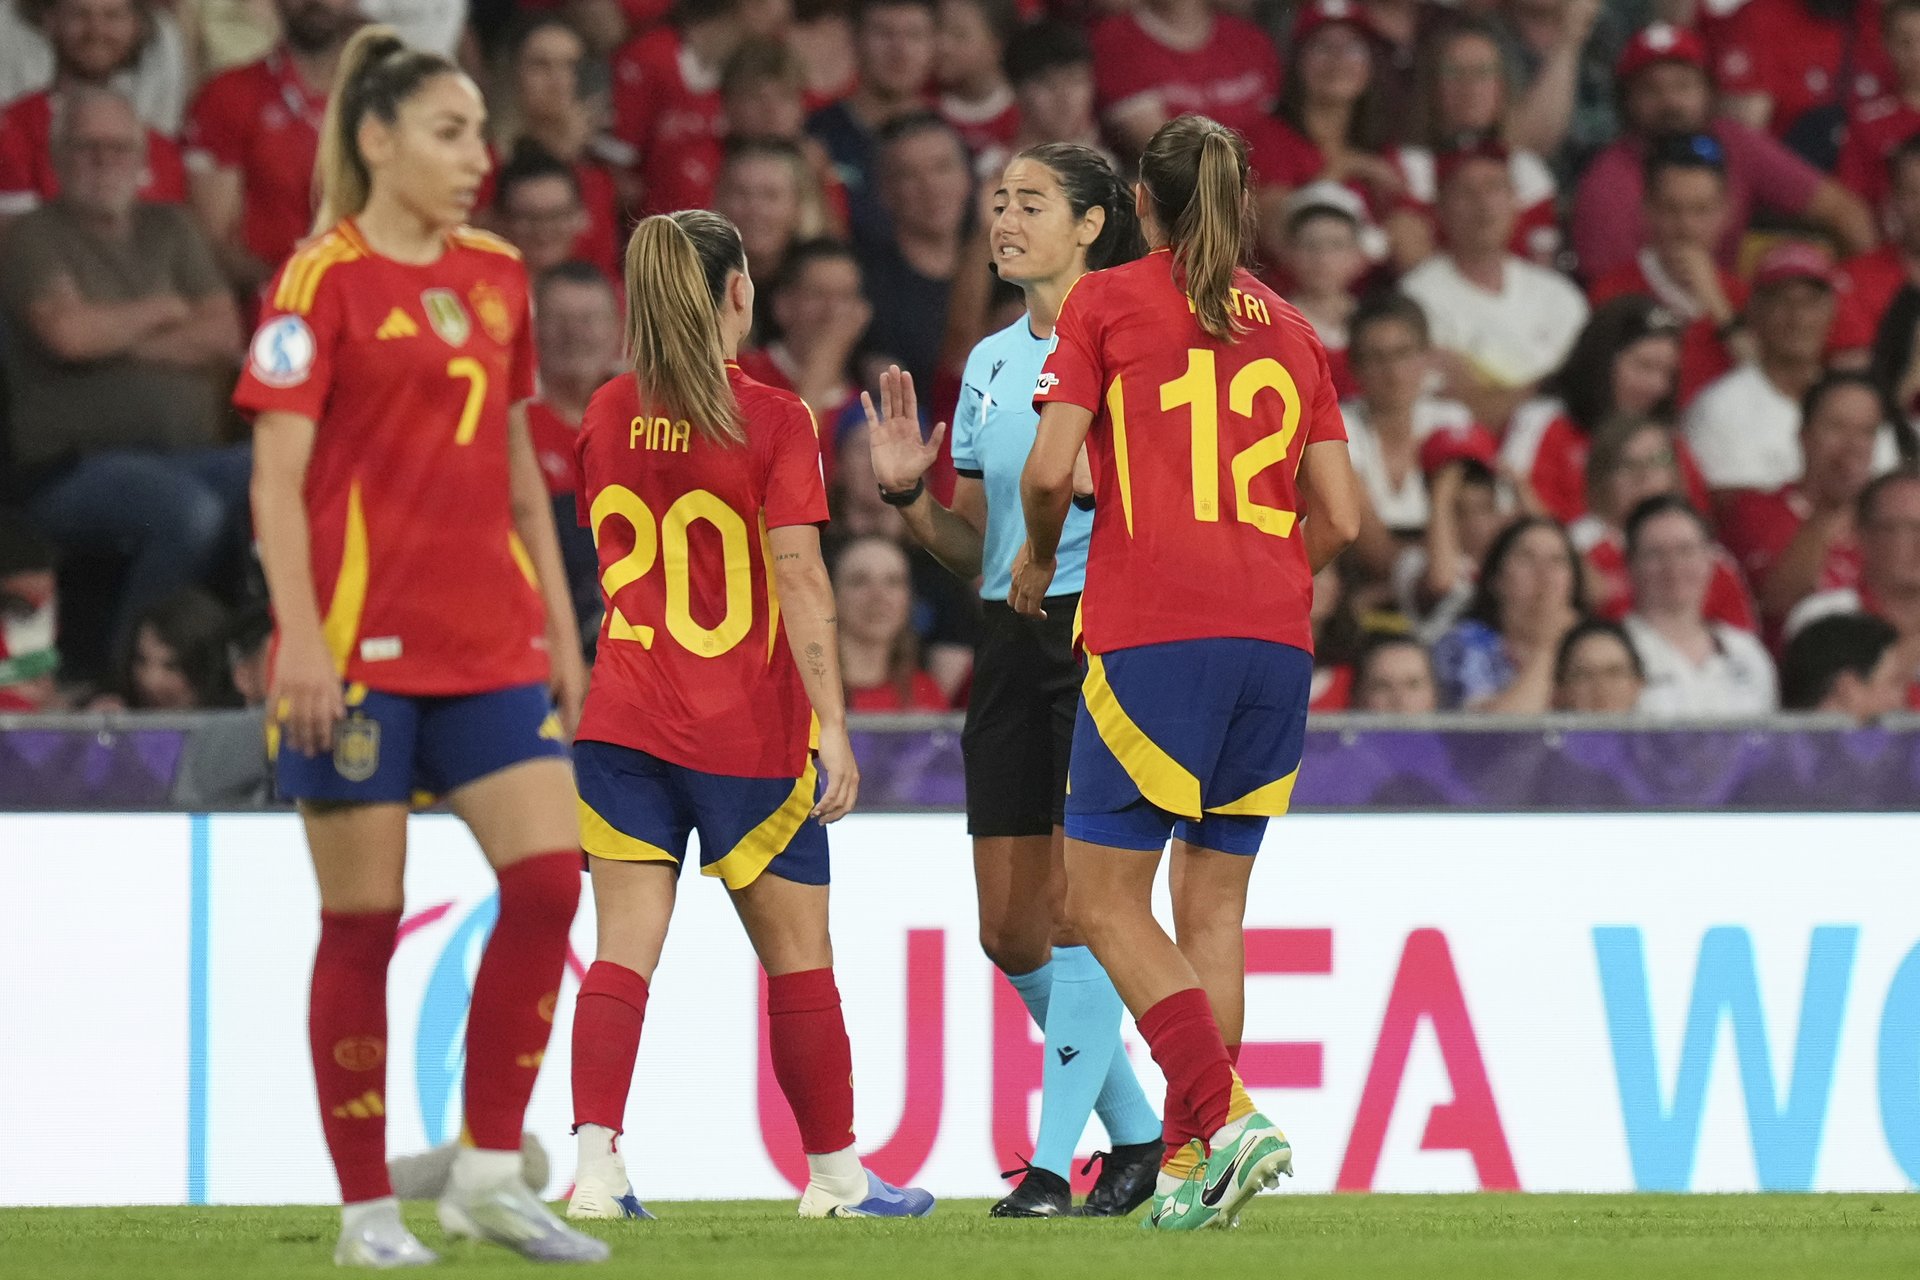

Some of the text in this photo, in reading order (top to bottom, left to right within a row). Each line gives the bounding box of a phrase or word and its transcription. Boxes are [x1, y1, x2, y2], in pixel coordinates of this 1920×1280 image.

[1185, 287, 1271, 326] TRI
[447, 356, 488, 445] 7
[629, 415, 691, 453] PINA
[1160, 348, 1300, 539] 12
[590, 484, 752, 658] 20
[1591, 924, 1920, 1192] W
